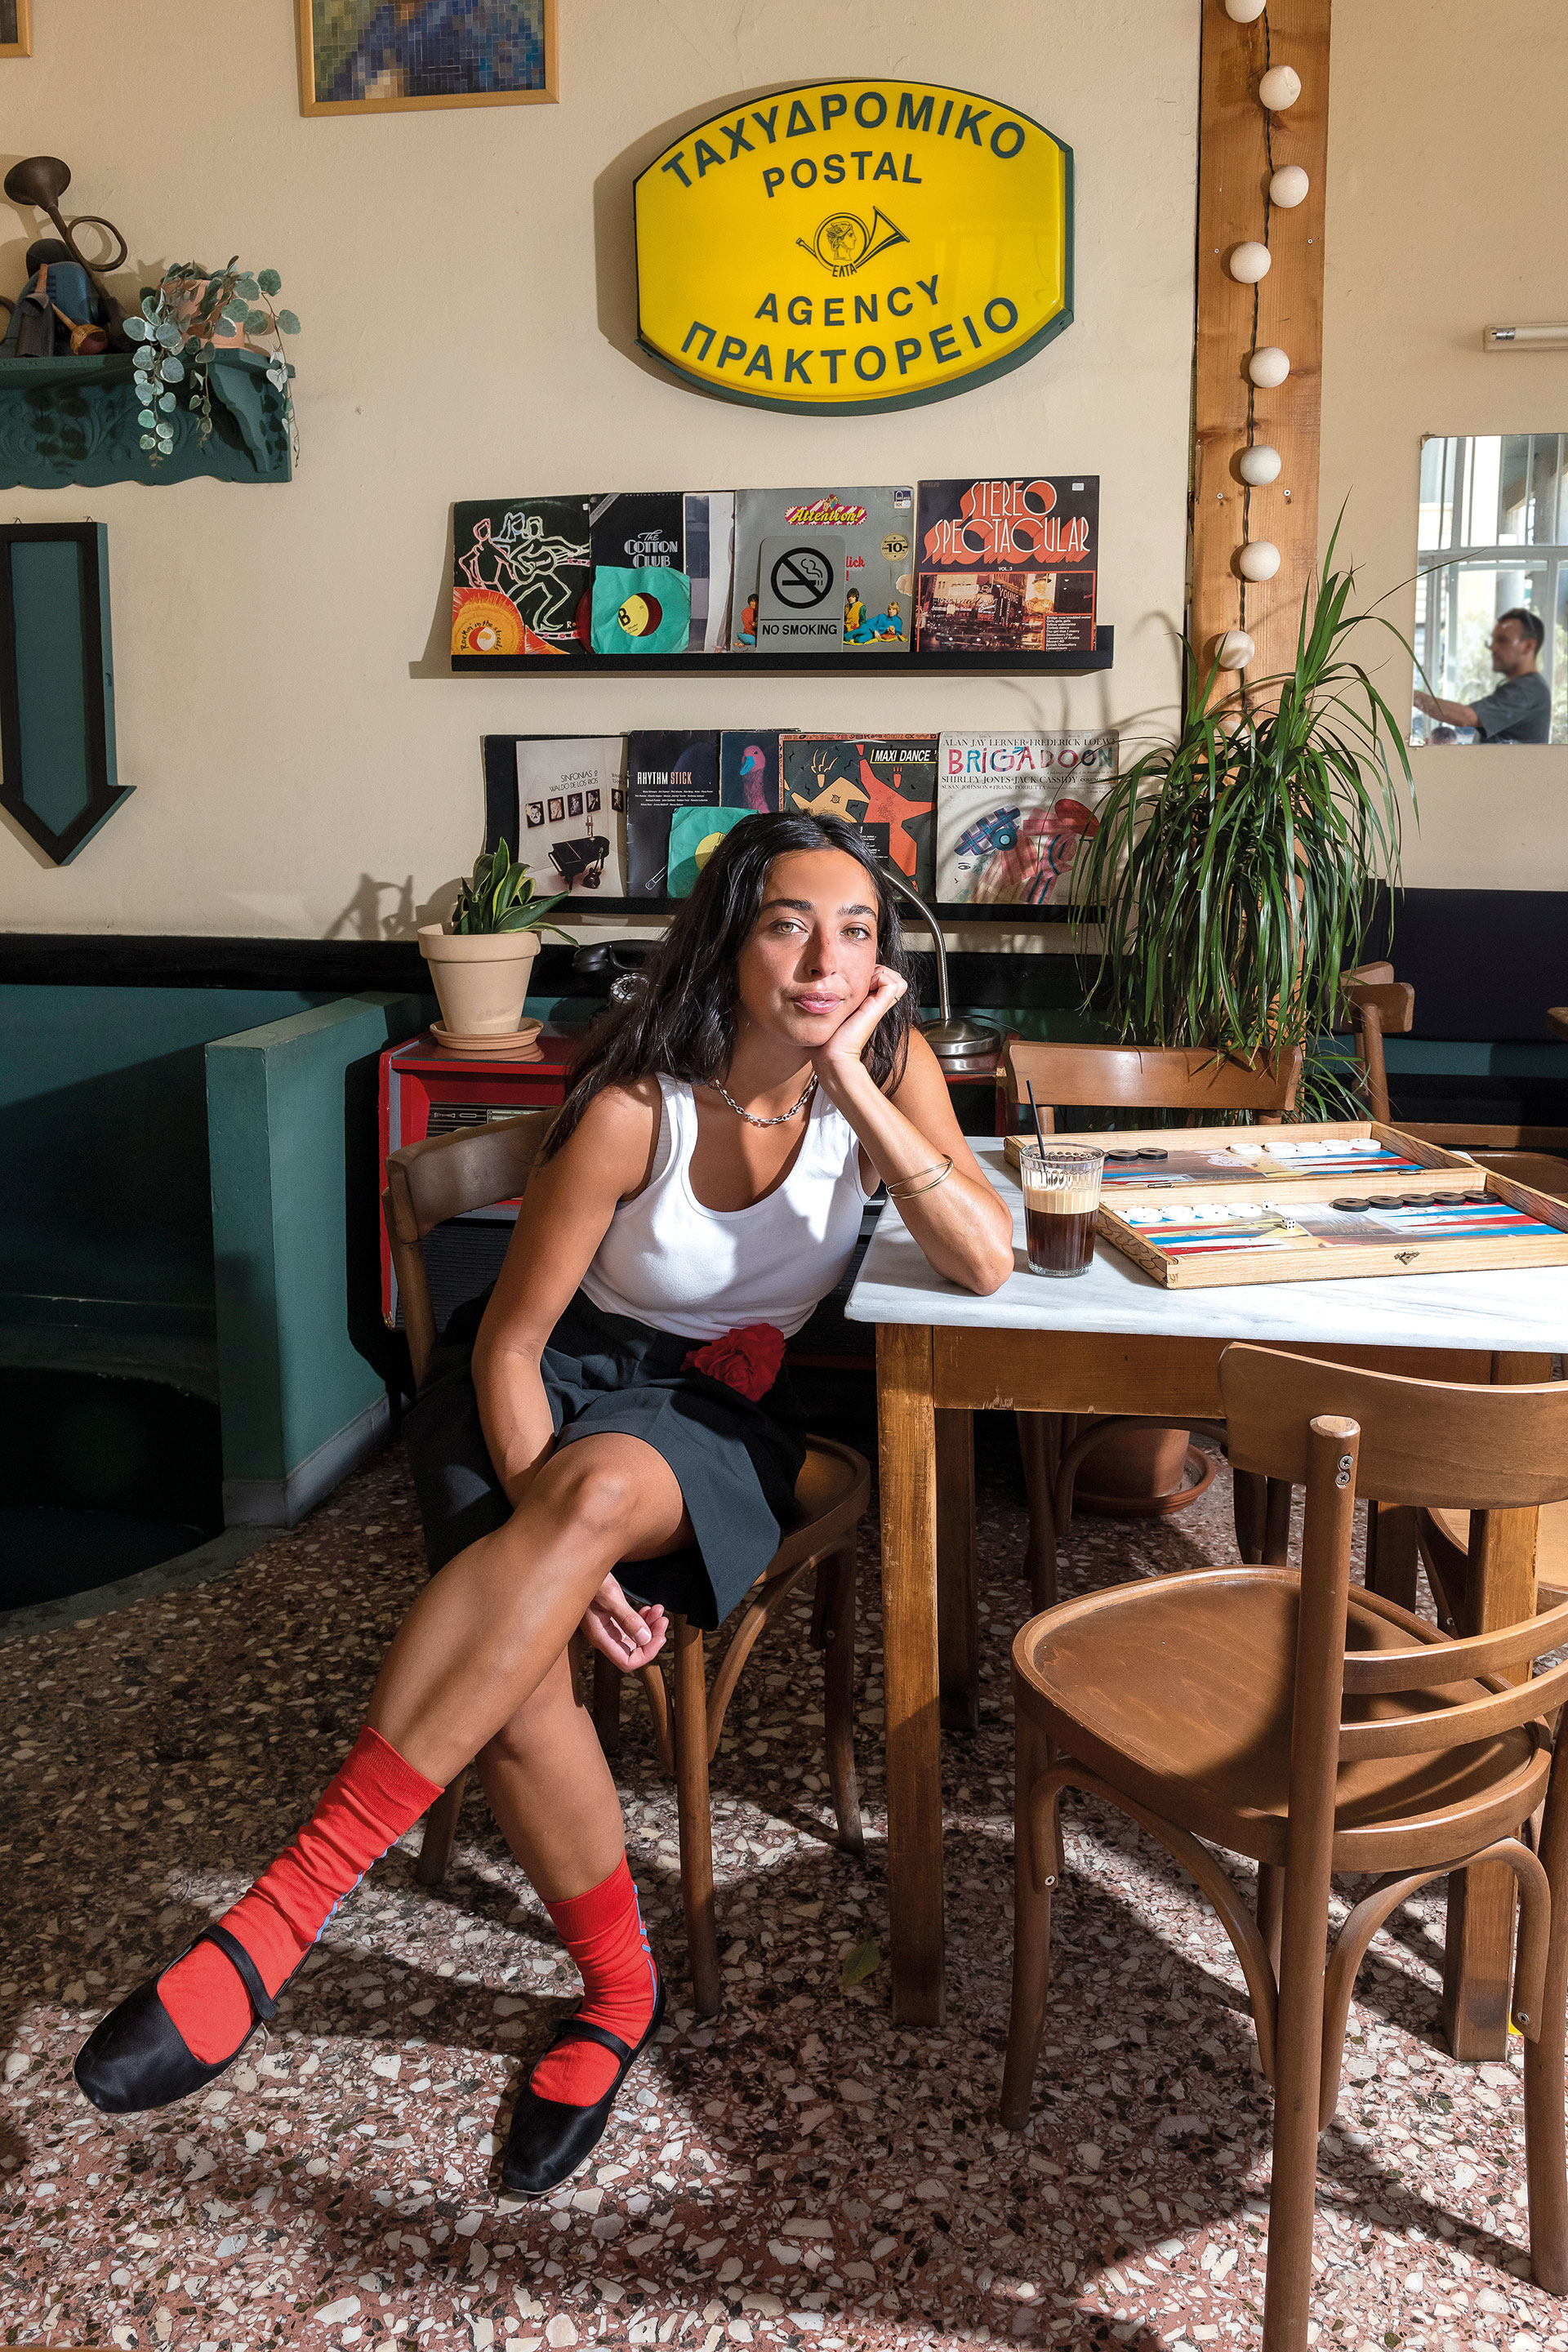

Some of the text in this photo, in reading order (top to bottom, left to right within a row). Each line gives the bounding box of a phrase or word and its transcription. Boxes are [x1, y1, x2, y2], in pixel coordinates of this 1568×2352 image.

[661, 91, 1026, 189] ΤΑΧΥΔΡΟΜΙΚΟ
[762, 150, 923, 198] POSTAL
[832, 263, 858, 278] ΕΛΤΑ
[754, 274, 939, 326] AGENCY
[680, 296, 1019, 384] ΠΡΑΚΤΟΡΕΙΟ
[968, 479, 1058, 517] STEREO
[791, 509, 862, 523] Attention!
[637, 529, 663, 541] The
[932, 516, 1091, 555] SPECTACULAR
[624, 539, 678, 555] COTTON
[632, 554, 671, 568] CLUB
[618, 608, 631, 627] B
[762, 624, 838, 635] NO SMOKING
[970, 739, 987, 747] JAY
[875, 750, 897, 761] MAXI
[899, 750, 930, 761] DANCE
[637, 772, 668, 785] RHYTHM
[670, 772, 693, 785] STICK
[982, 776, 1011, 784] JONES
[1013, 776, 1036, 784] JACK
